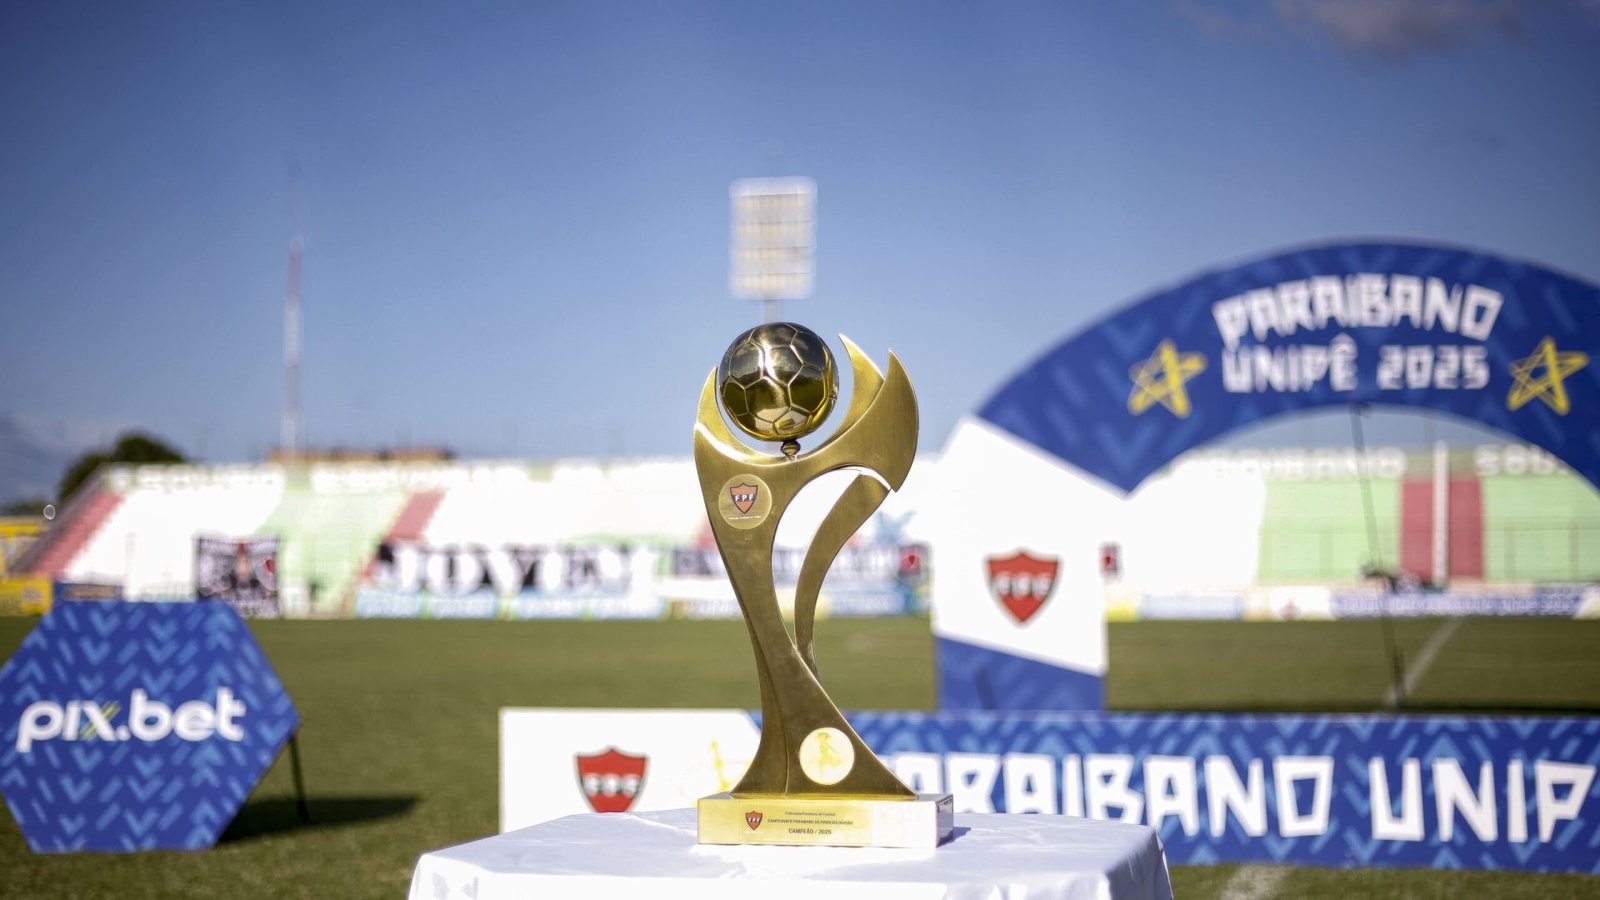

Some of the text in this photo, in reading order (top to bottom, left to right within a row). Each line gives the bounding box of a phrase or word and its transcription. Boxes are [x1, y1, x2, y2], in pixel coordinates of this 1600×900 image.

[1213, 272, 1504, 352] PARAIBANO
[1222, 333, 1490, 394] UNIPÊ 2025
[735, 494, 754, 502] FPF
[16, 687, 246, 752] pix.bet
[880, 752, 1597, 843] ARAIBANO UNIP
